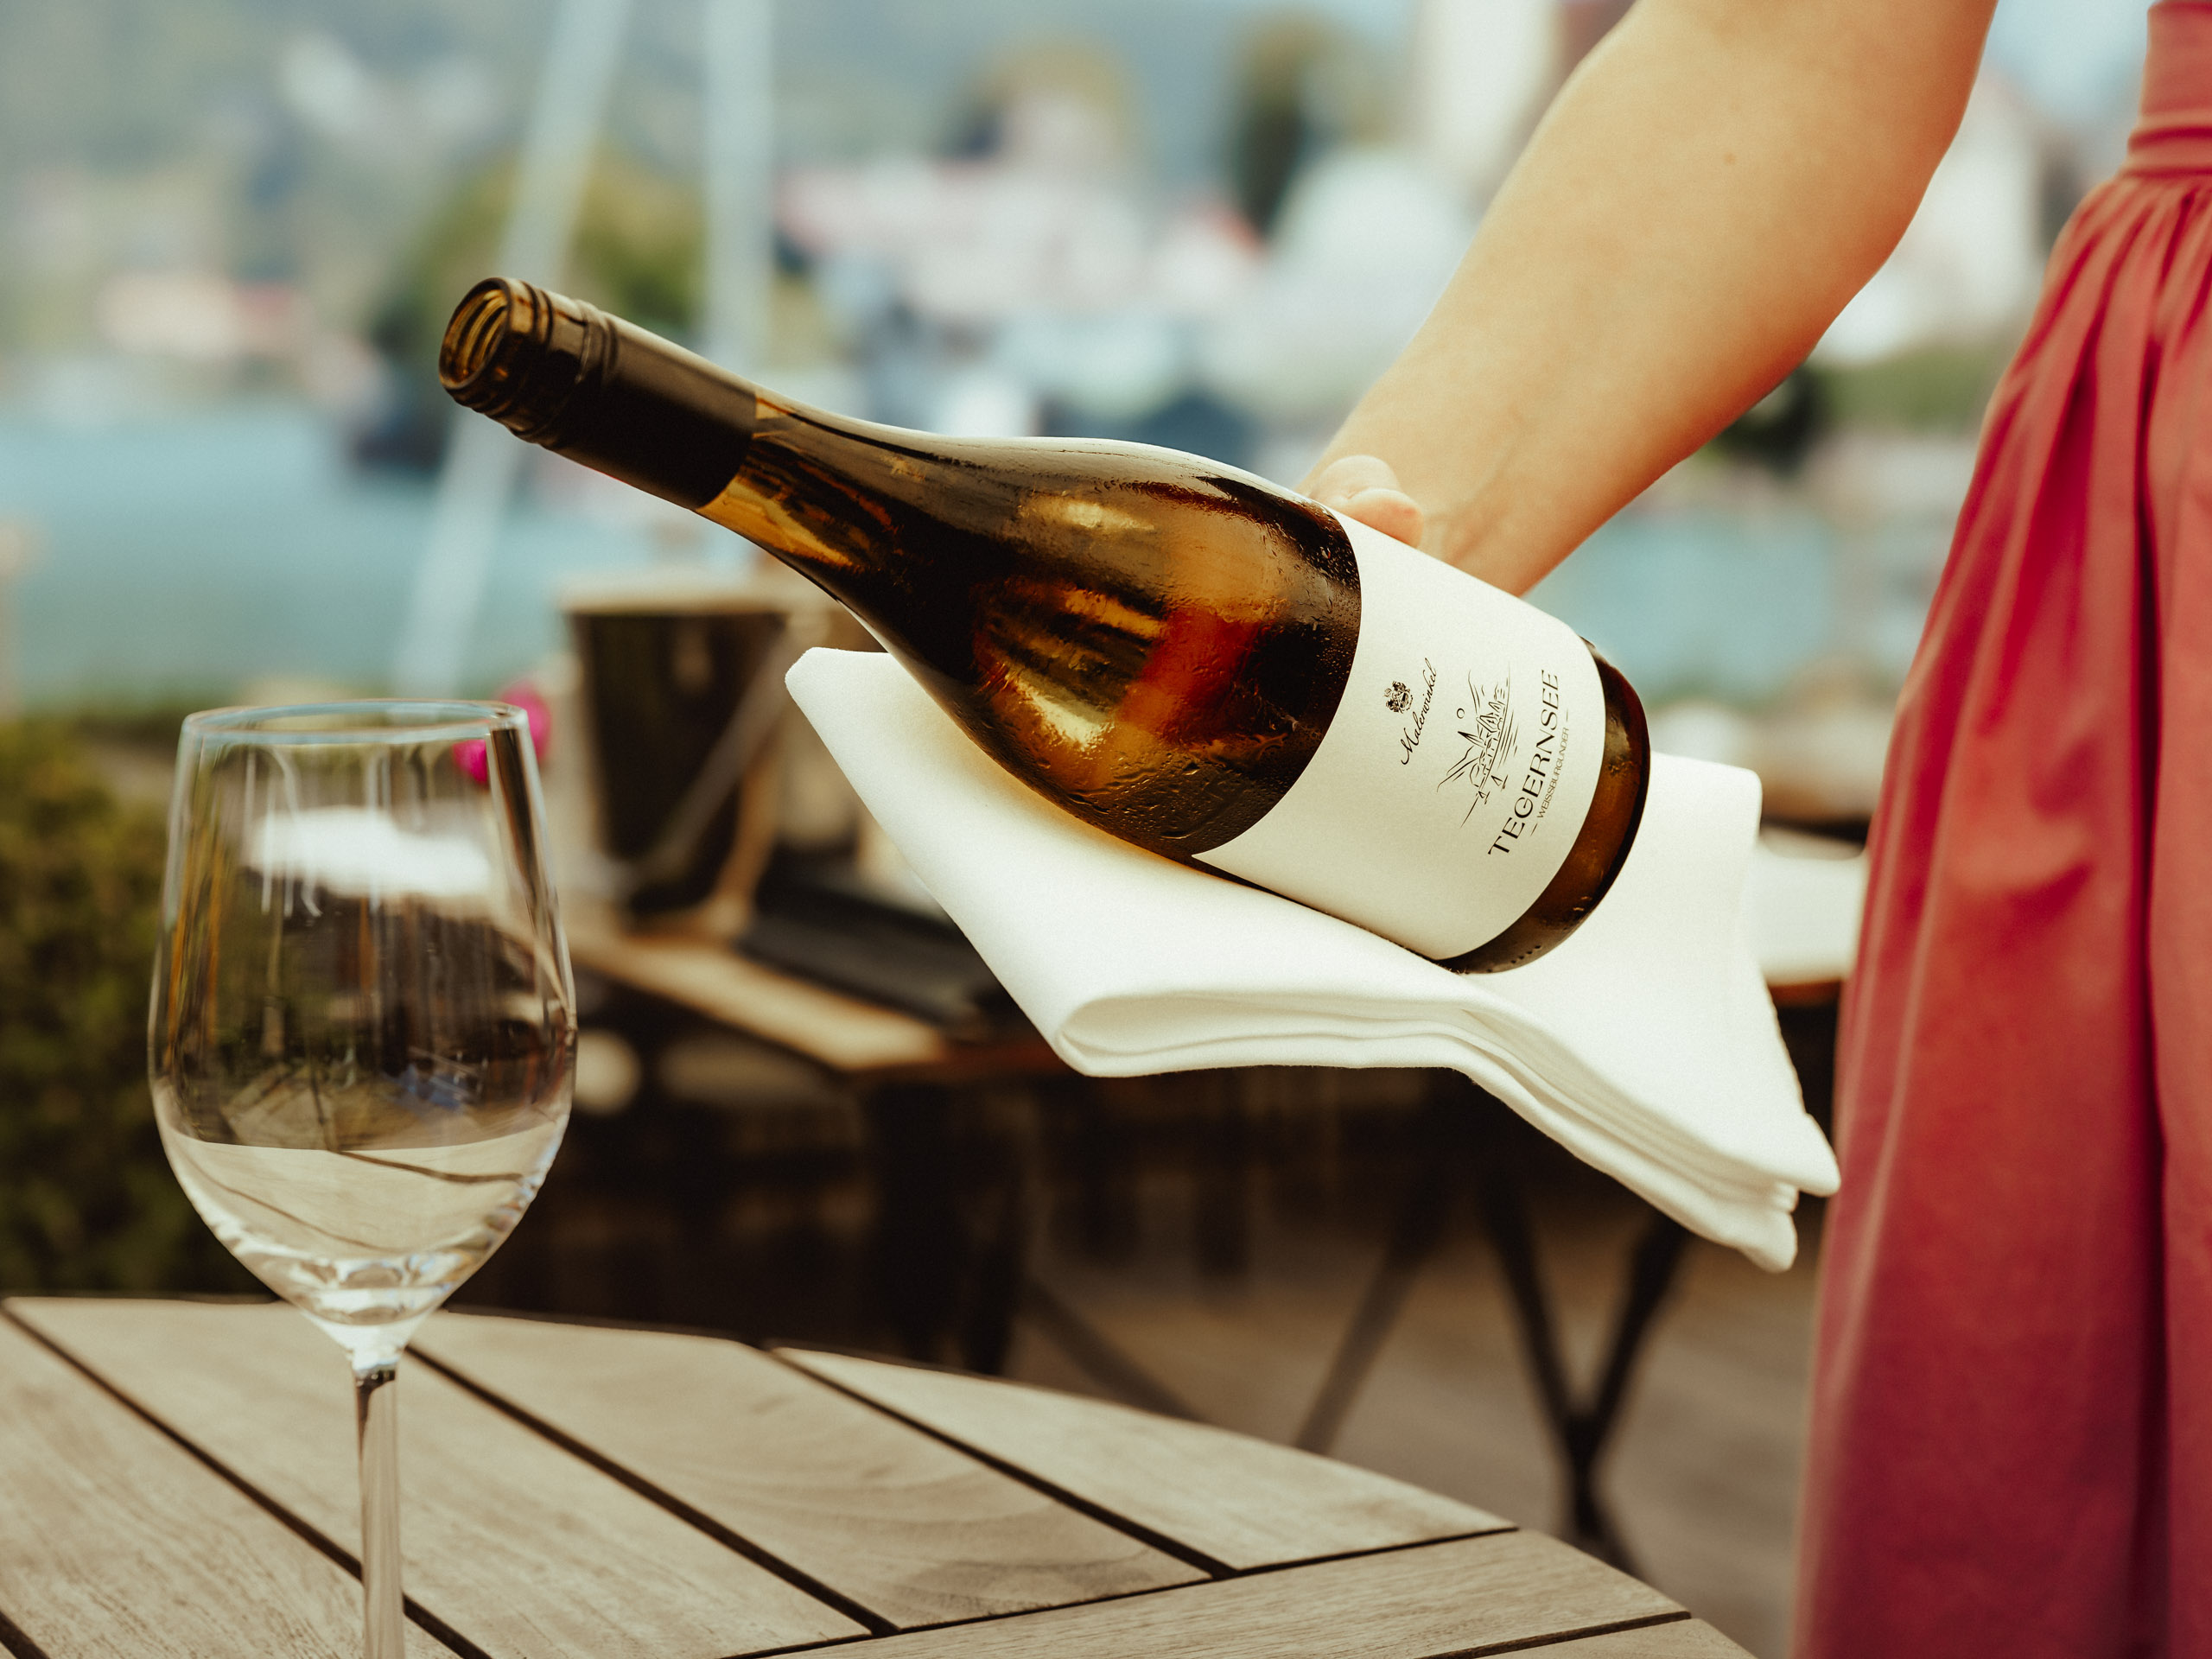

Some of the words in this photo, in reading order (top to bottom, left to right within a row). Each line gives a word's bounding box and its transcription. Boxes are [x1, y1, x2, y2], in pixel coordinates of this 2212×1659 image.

[1400, 657, 1437, 766] Malerwinkel
[1487, 669, 1560, 855] TEGERNSEE
[1536, 727, 1569, 818] WEISSBURGUNDER
